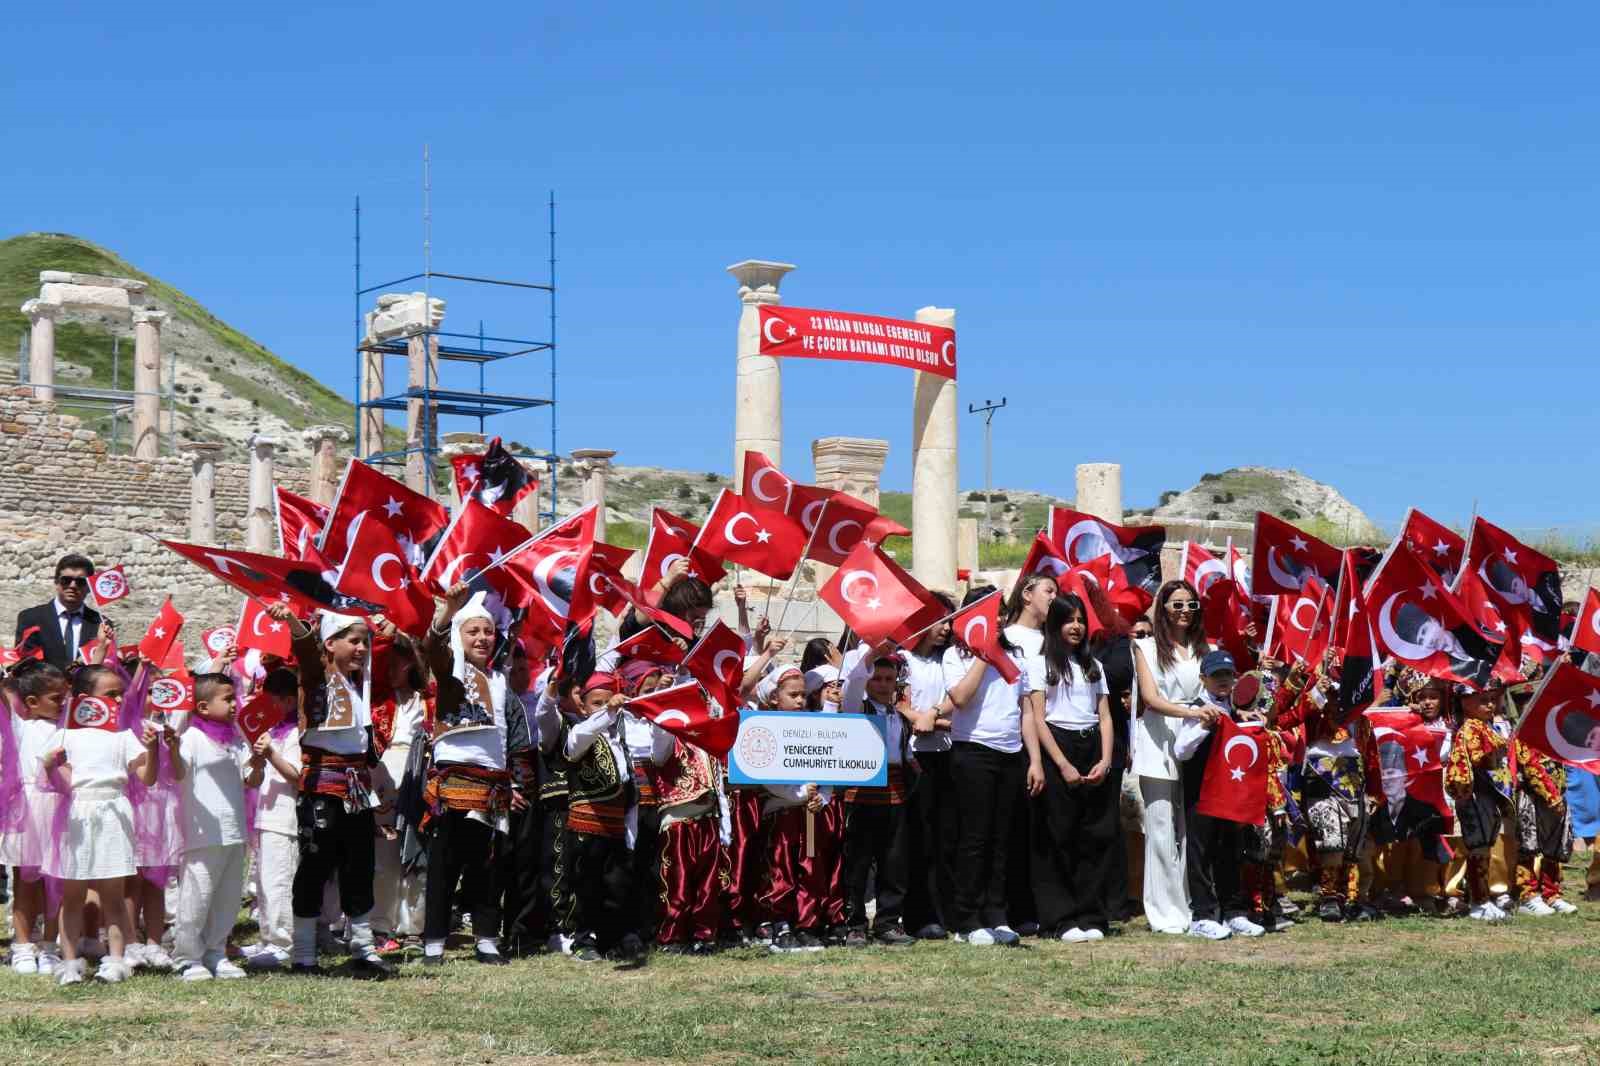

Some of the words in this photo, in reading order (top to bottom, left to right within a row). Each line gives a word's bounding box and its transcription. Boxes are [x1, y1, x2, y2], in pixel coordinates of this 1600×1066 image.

[809, 317, 823, 330] 23
[824, 316, 852, 333] NİSAN
[852, 320, 886, 337] ULUSAL
[886, 325, 932, 345] EGEMENLİK
[803, 335, 815, 350] VE
[817, 335, 848, 354] ÇOCUK
[849, 338, 888, 356] BAYRAMI
[889, 343, 915, 361] KUTLU
[916, 348, 939, 367] OLSUN
[783, 757, 837, 769] CUMHURİYET
[838, 758, 877, 770] İLKOKULU
